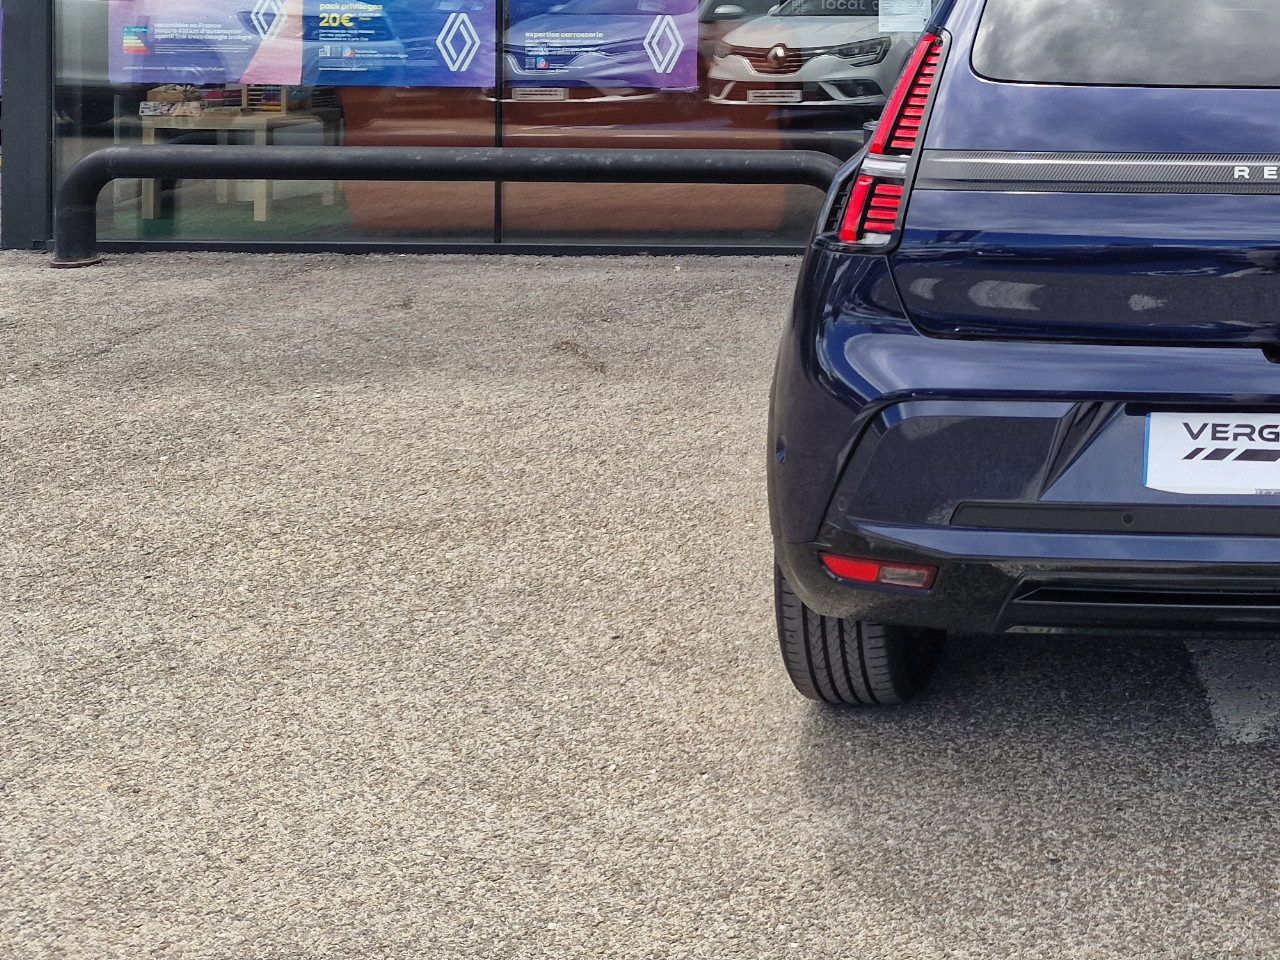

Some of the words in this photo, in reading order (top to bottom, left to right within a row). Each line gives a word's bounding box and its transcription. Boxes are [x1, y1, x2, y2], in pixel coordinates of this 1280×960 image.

[319, 12, 355, 28] 20€
[525, 31, 560, 39] expertise
[560, 31, 604, 39] carrosserie
